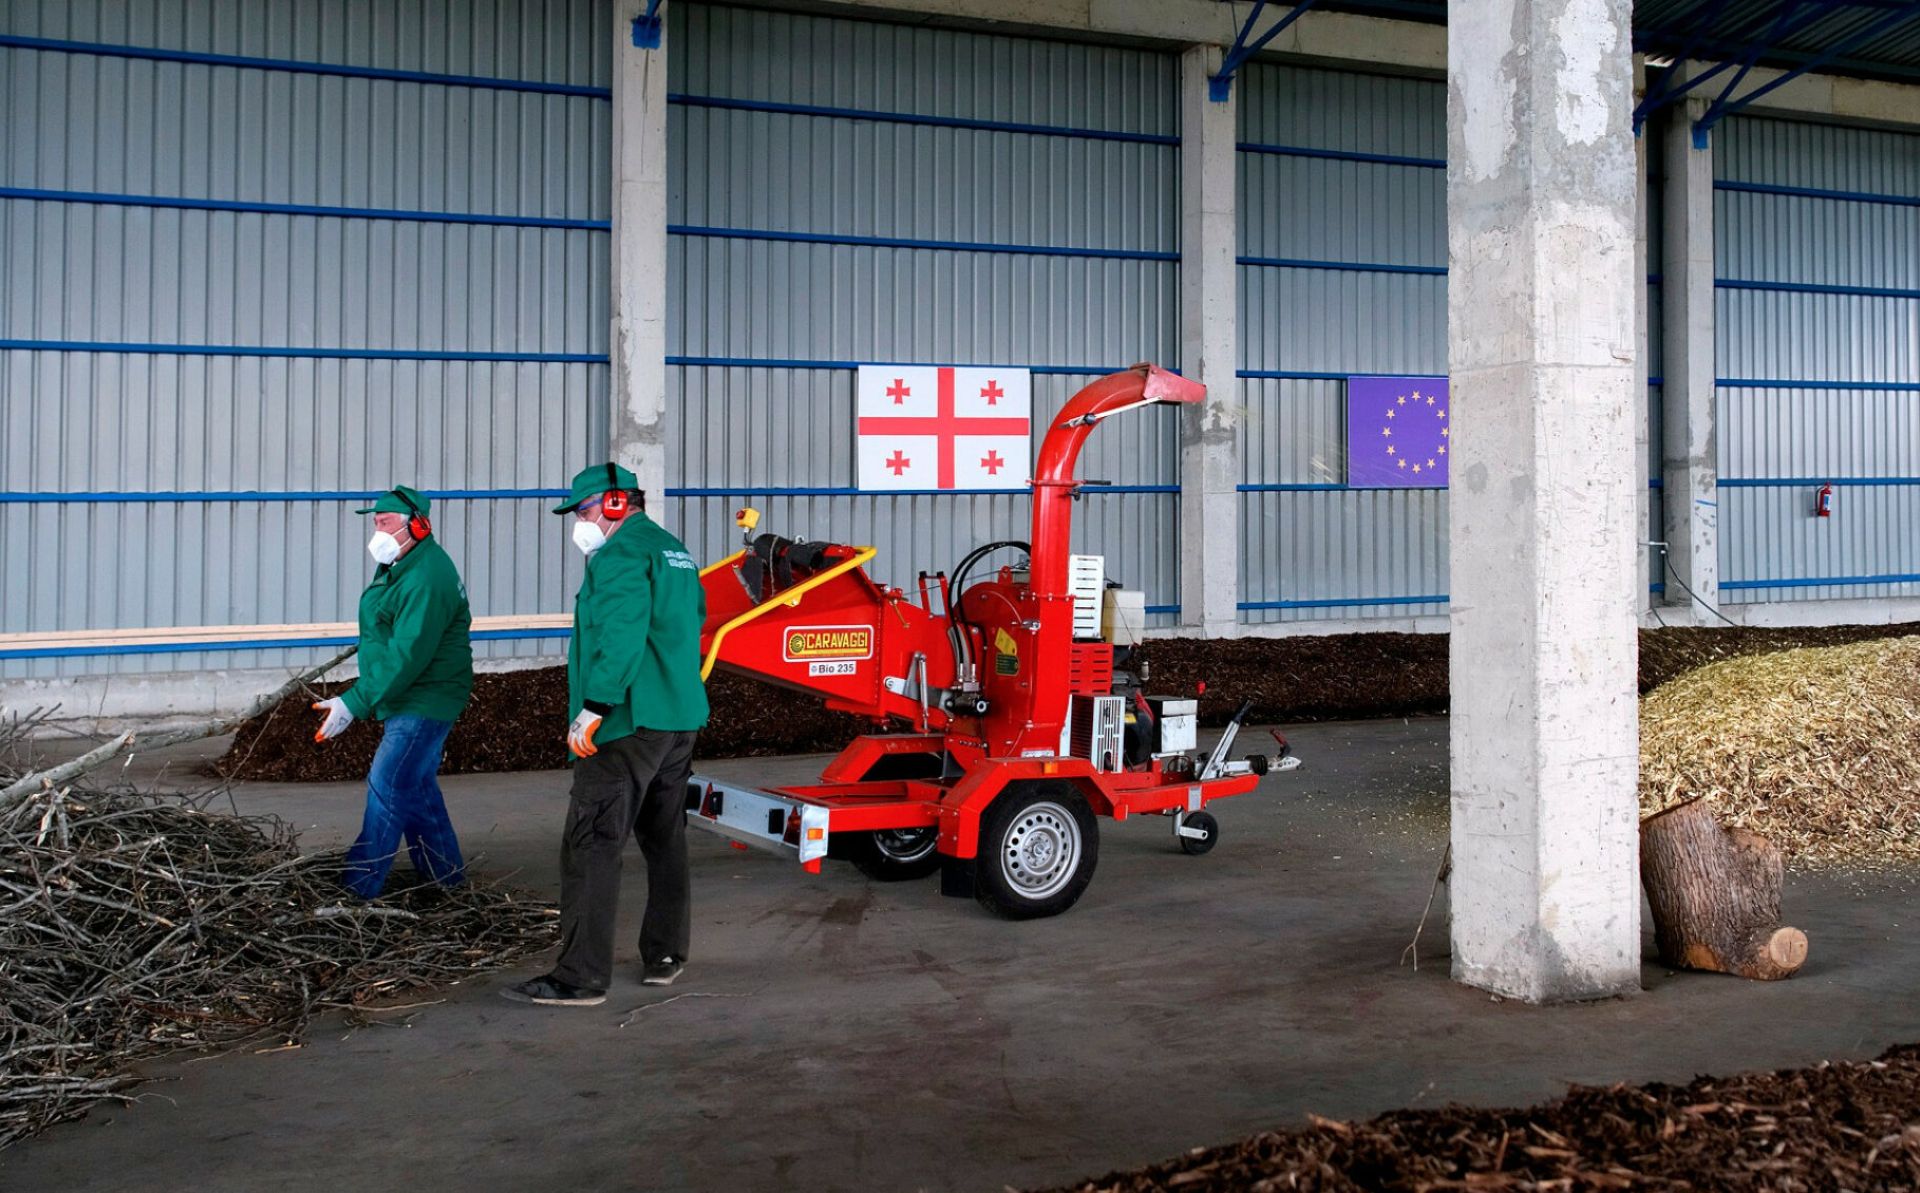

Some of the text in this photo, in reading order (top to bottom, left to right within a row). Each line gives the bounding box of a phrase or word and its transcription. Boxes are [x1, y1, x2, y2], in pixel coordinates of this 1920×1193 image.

[806, 632, 868, 649] CARAVAGGI
[818, 663, 854, 674] Bio 235
